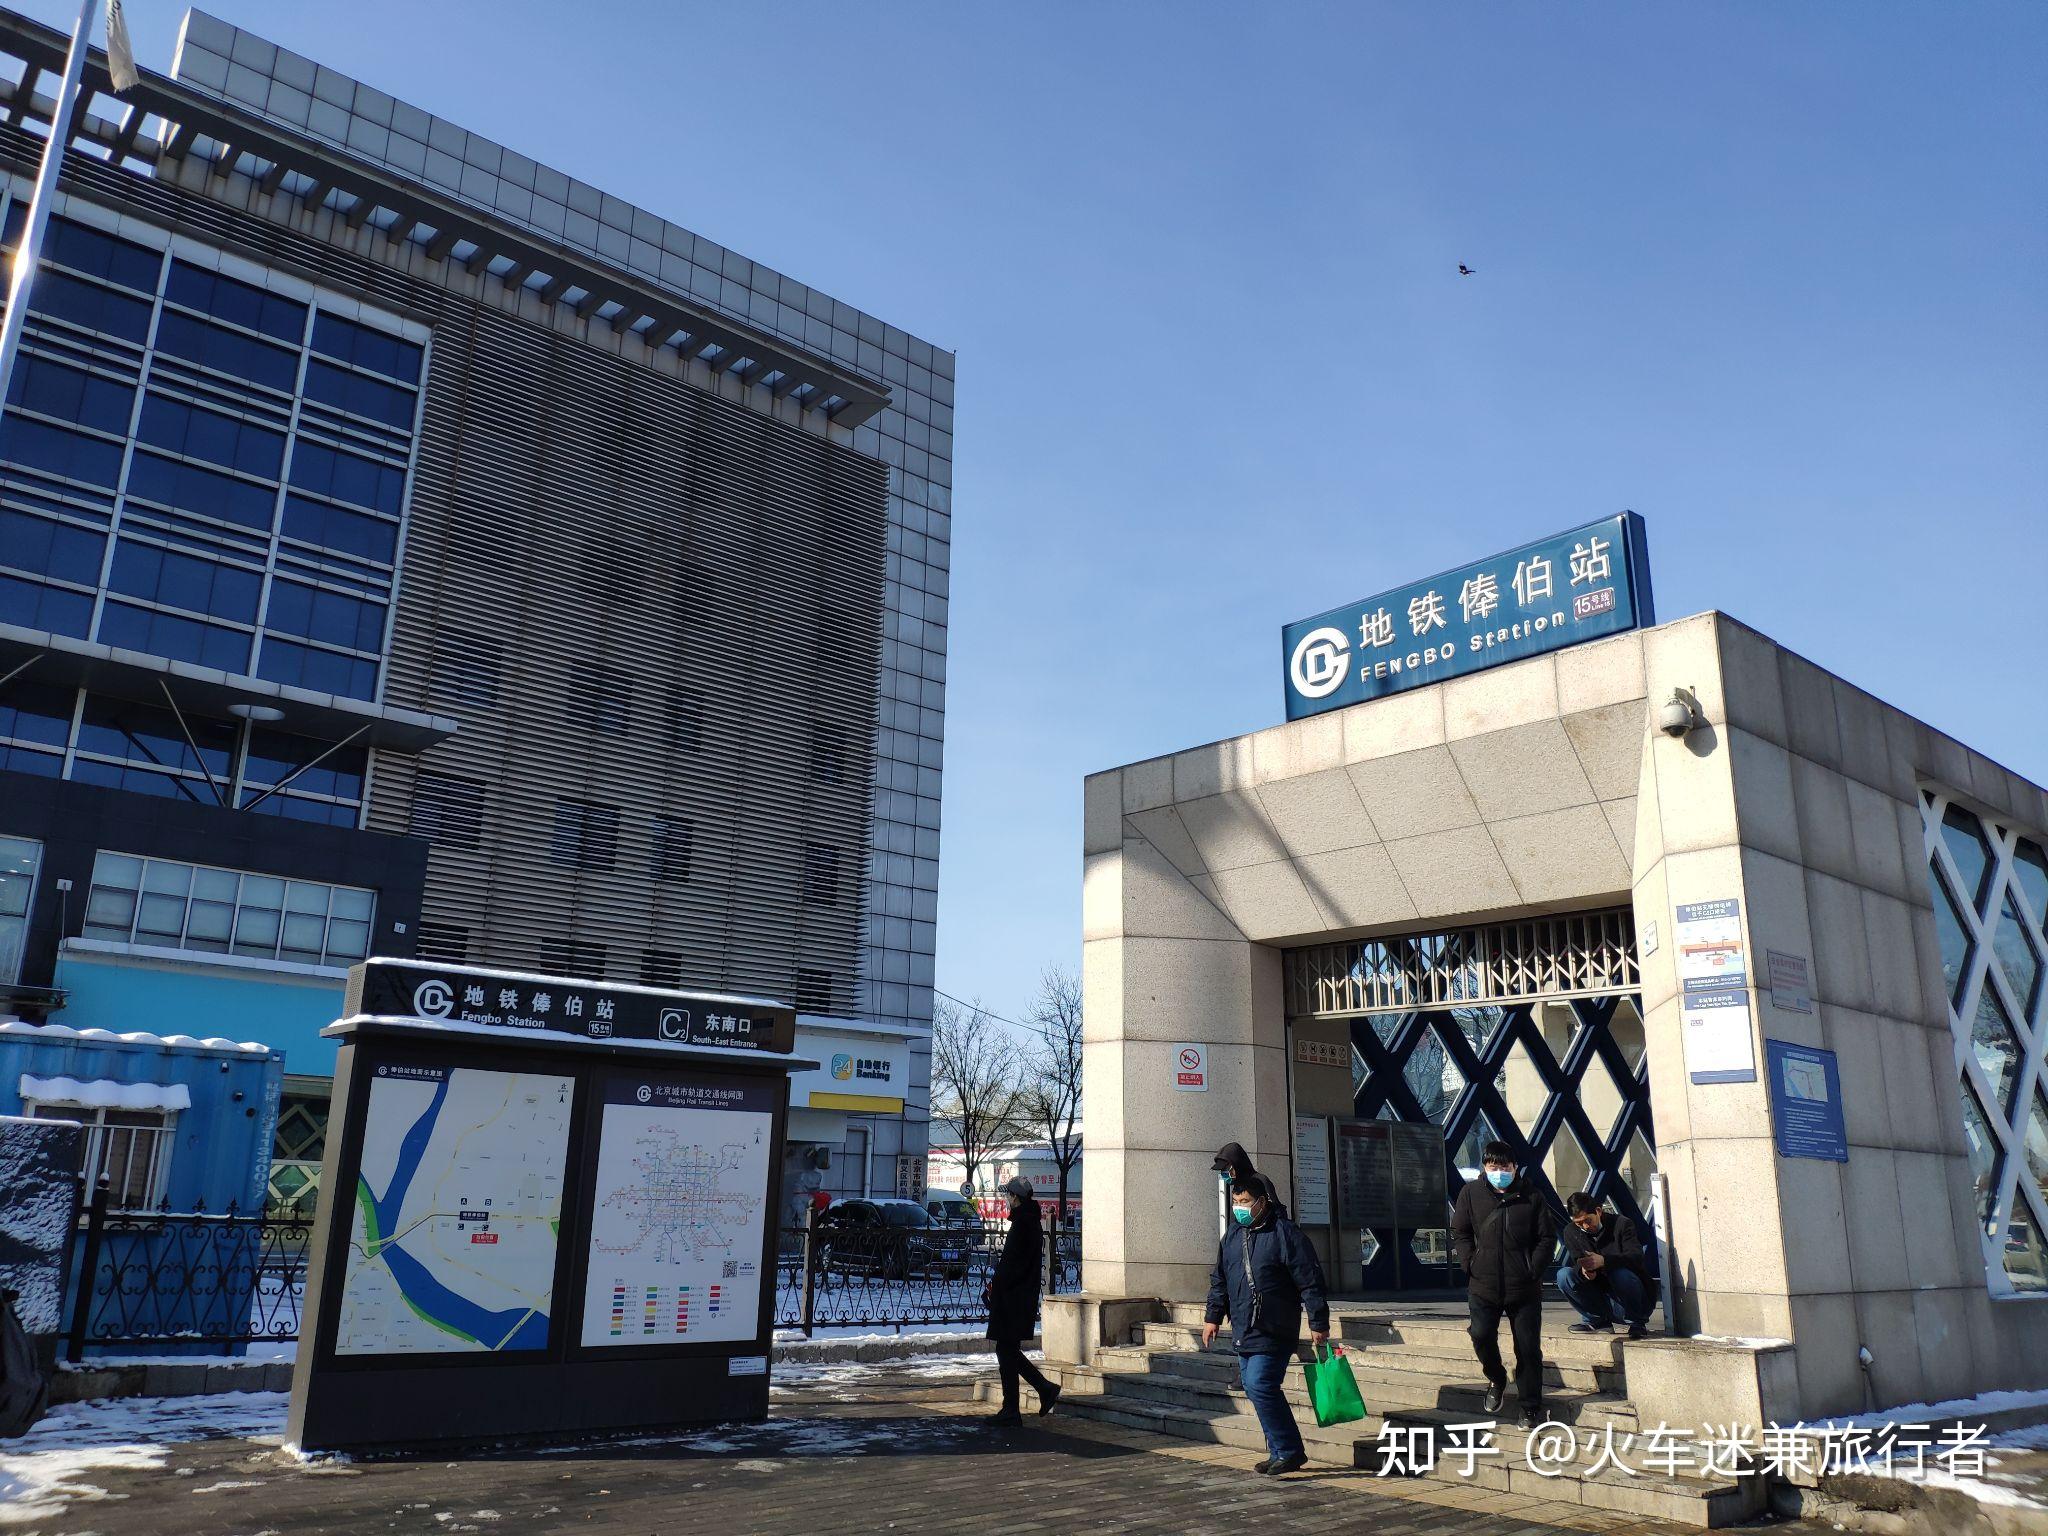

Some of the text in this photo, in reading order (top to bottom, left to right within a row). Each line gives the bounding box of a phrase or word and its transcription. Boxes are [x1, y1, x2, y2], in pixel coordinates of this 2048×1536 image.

[1359, 537, 1611, 650] 地铁俸伯站
[1360, 611, 1566, 683] FENGBO Station
[464, 985, 615, 1020] 地铁俸伯站
[461, 1010, 546, 1028] Fengbo Station
[705, 1013, 751, 1034] 东南口
[692, 1034, 758, 1048] South-East Entrance
[856, 1059, 890, 1071] 自助银行
[856, 1069, 890, 1081] Banking
[964, 1184, 971, 1195] 5
